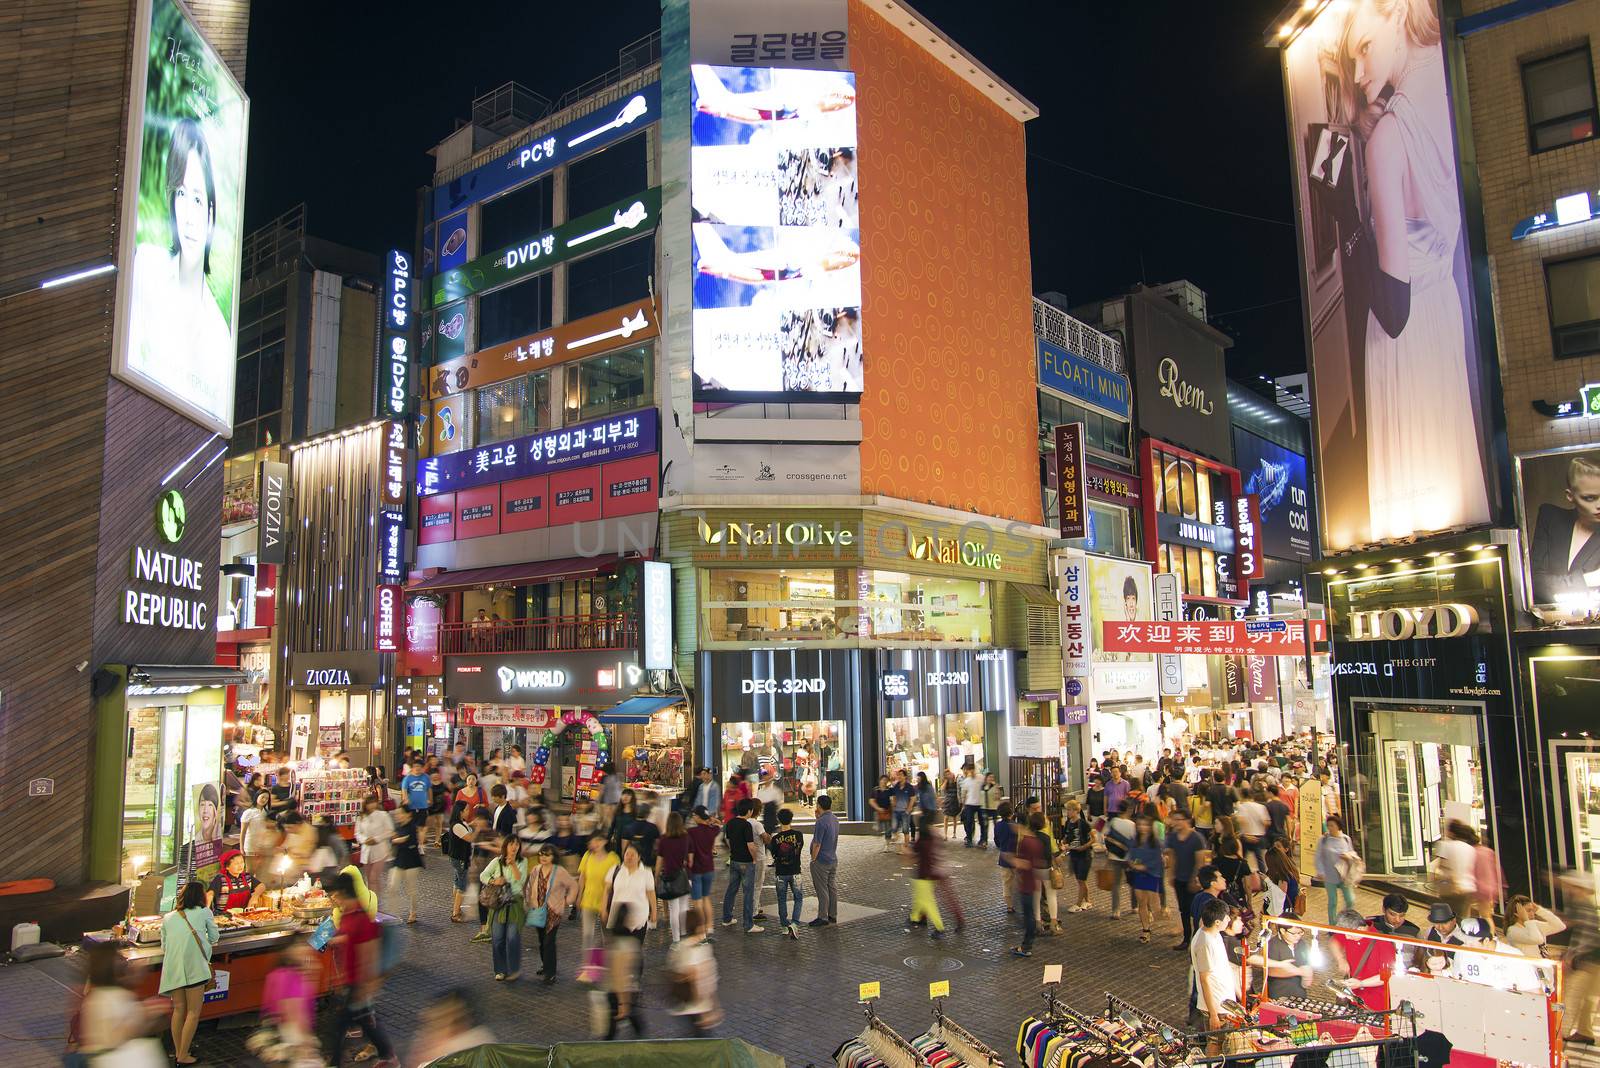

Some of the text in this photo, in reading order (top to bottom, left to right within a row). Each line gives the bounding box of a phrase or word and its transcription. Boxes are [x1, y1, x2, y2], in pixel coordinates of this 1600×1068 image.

[731, 30, 847, 63] 글로벌을
[521, 137, 556, 168] PC방
[507, 234, 555, 269] DVD방
[517, 337, 554, 362] 노래방
[1044, 351, 1094, 390] FLOATI
[1098, 375, 1125, 402] MINI
[1158, 357, 1214, 416] Roem
[786, 472, 847, 482] crossgene.net
[1063, 466, 1078, 522] 성형외과
[1291, 486, 1307, 508] run
[266, 476, 282, 549] ZIOZIA
[1289, 510, 1308, 532] cool
[727, 522, 782, 546] Nail
[785, 522, 853, 546] Olive
[1179, 522, 1216, 544] JUNO HAIR
[927, 536, 961, 565] Nail
[962, 541, 1002, 570] Olive
[1241, 553, 1254, 575] 3
[135, 546, 203, 591] NATURE
[125, 589, 207, 631] REPUBLIC
[380, 589, 393, 637] COFFEE
[1391, 658, 1436, 668] THE GIFT
[306, 669, 351, 685] ZIOZIA
[516, 670, 565, 688] WORLD
[742, 678, 826, 694] DEC.32ND
[885, 675, 907, 685] DEC.
[927, 671, 969, 686] DEC.32ND
[885, 686, 908, 695] 32ND
[1450, 686, 1501, 696] www.lloydgift.com
[1467, 964, 1479, 976] 99
